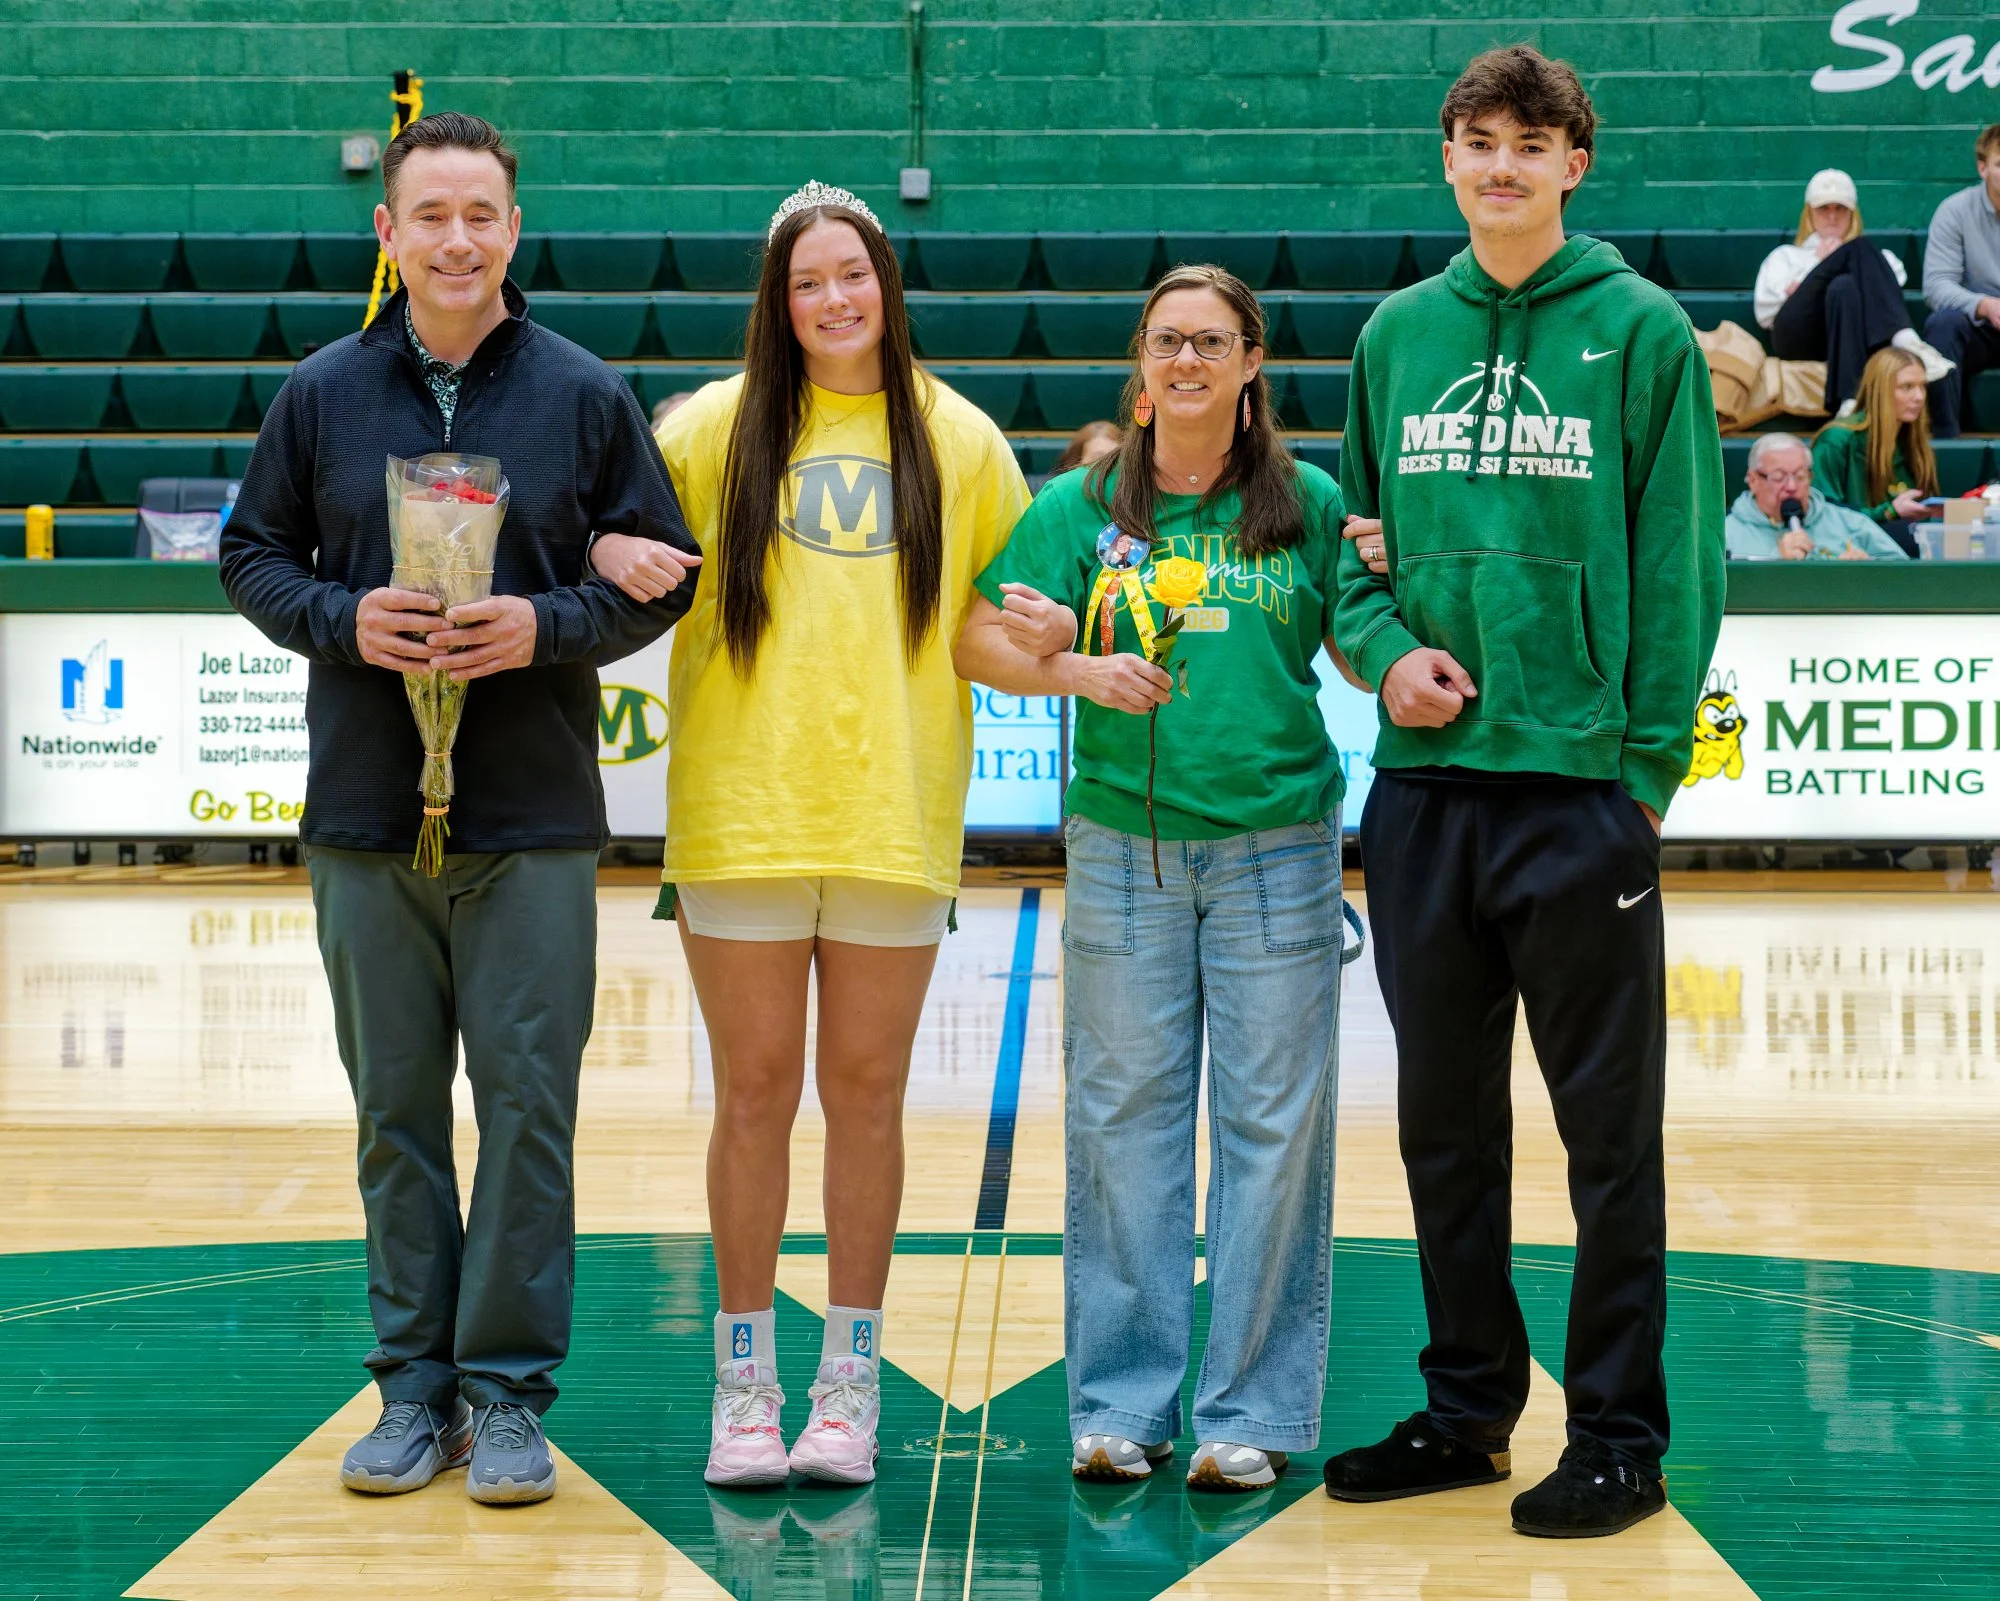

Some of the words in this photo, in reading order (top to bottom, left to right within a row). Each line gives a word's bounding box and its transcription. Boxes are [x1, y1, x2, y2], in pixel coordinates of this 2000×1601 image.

[1401, 412, 1594, 457] MEDINA
[1398, 453, 1442, 475] BEES
[784, 462, 896, 549] M
[1114, 533, 1294, 625] ENIOR
[1174, 609, 1225, 630] 026
[198, 651, 232, 674] Joe
[239, 651, 293, 674] Lazor
[1789, 657, 1920, 684] HOME
[1934, 657, 1994, 684] OF
[199, 687, 238, 703] Lazor
[199, 716, 306, 733] 330-722-4444
[1764, 699, 2000, 753] MEDI
[22, 735, 158, 755] Nationwide
[1766, 768, 1985, 795] BATTLING
[190, 789, 238, 822] Go
